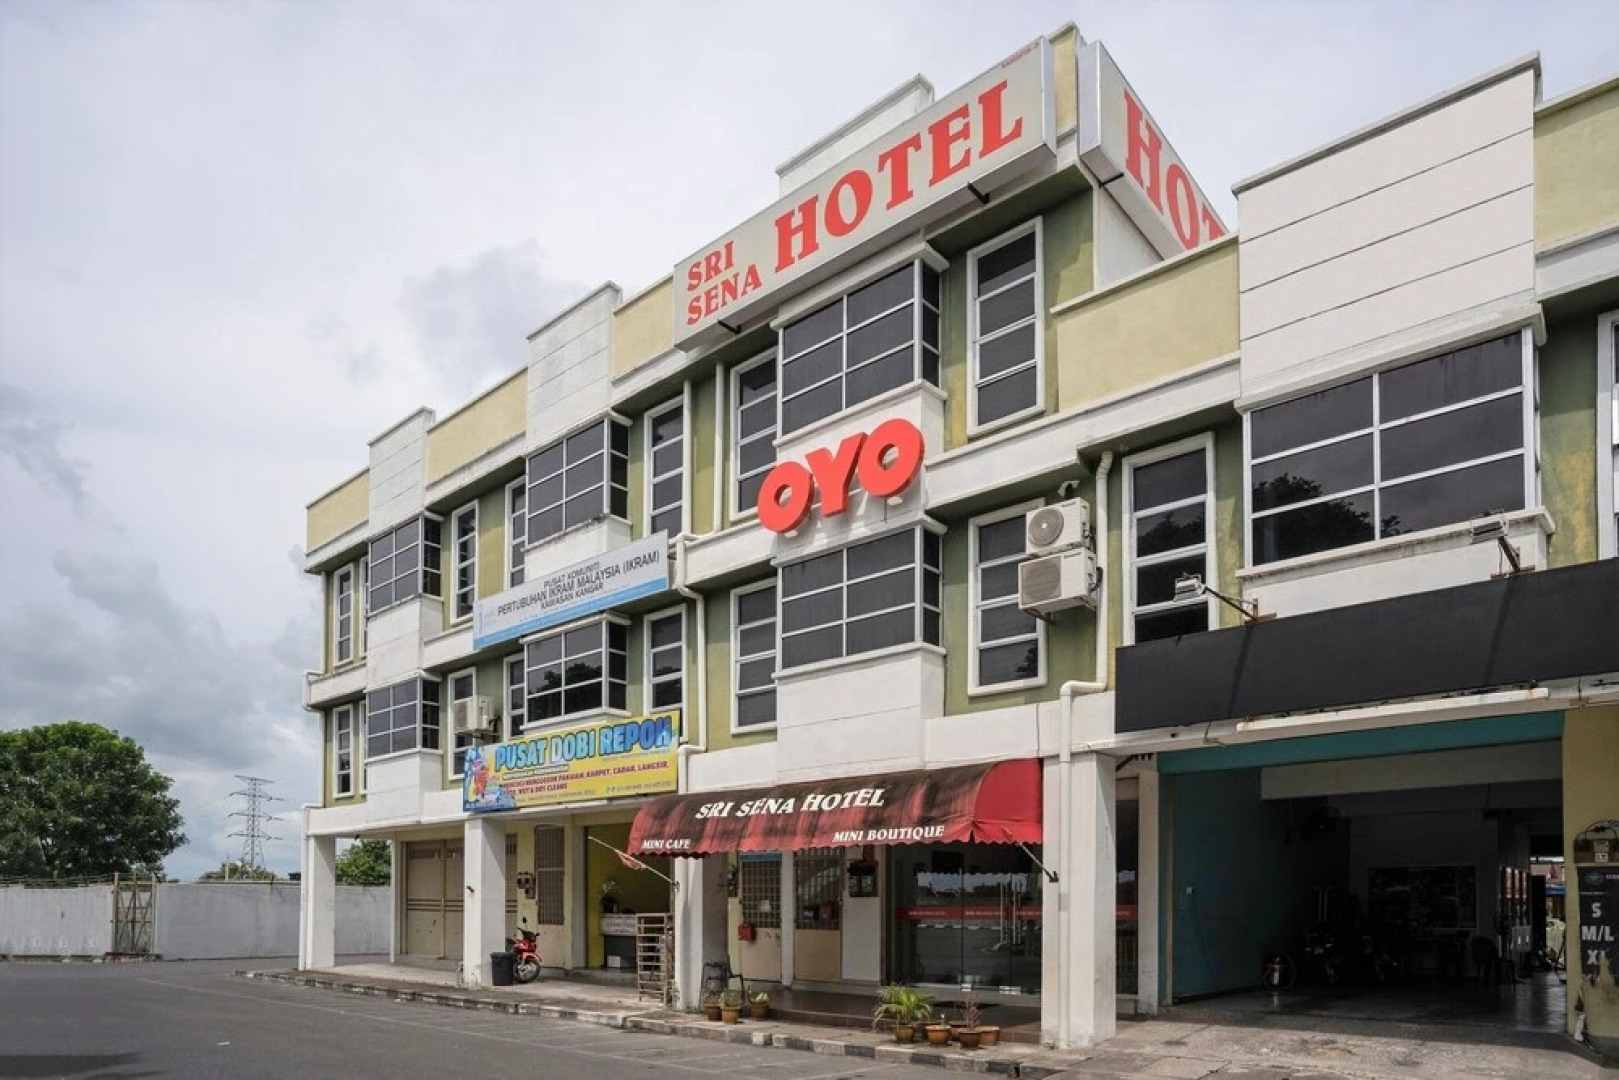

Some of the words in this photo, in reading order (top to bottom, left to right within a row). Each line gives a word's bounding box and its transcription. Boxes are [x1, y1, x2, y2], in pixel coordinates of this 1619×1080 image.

[775, 79, 1024, 273] HOTEL
[687, 240, 734, 292] SRI
[687, 263, 762, 325] SENA
[757, 418, 925, 534] OYO
[497, 590, 547, 617] PERTUBUHAN
[548, 579, 575, 600] IKRAM
[577, 563, 621, 591] MALAYSIA
[622, 550, 660, 574] (IKRAM)
[543, 572, 566, 588] PUSAT
[495, 737, 548, 772] PUSAT
[551, 729, 596, 763] DOBI
[695, 801, 735, 819] SRI
[735, 797, 796, 817] SENA
[800, 788, 886, 812] HOTEL
[641, 839, 664, 849] MINI
[665, 838, 691, 849] CAFE
[832, 830, 864, 843] MINI
[866, 825, 945, 841] BOUTIQUE
[1592, 902, 1602, 918] S
[1581, 925, 1615, 942] M/L
